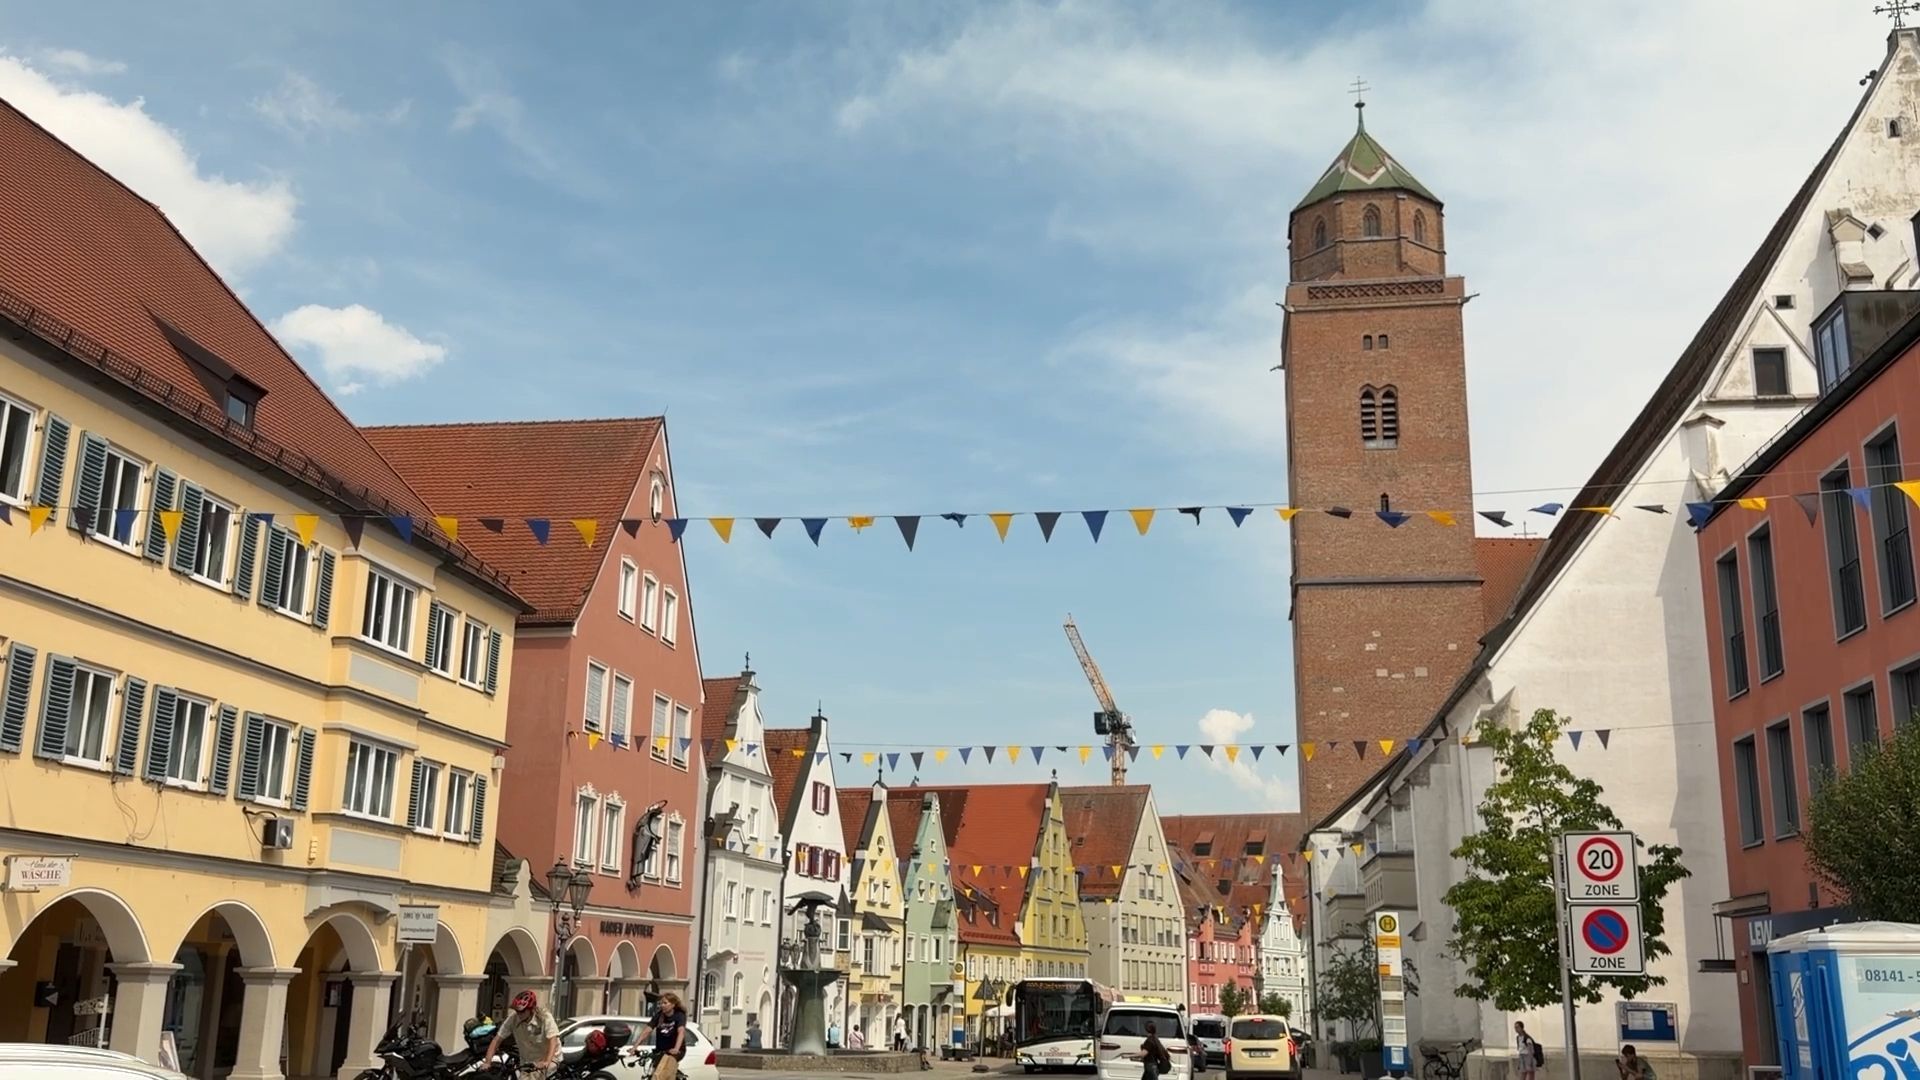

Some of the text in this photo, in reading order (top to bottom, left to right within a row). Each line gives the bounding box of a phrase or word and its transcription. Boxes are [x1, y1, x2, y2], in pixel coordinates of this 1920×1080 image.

[1587, 849, 1614, 870] 20
[1585, 884, 1620, 896] ZONE
[1383, 918, 1392, 929] H
[1749, 919, 1773, 946] LEW
[1590, 956, 1626, 969] ZONE
[1865, 968, 1905, 982] 08141
